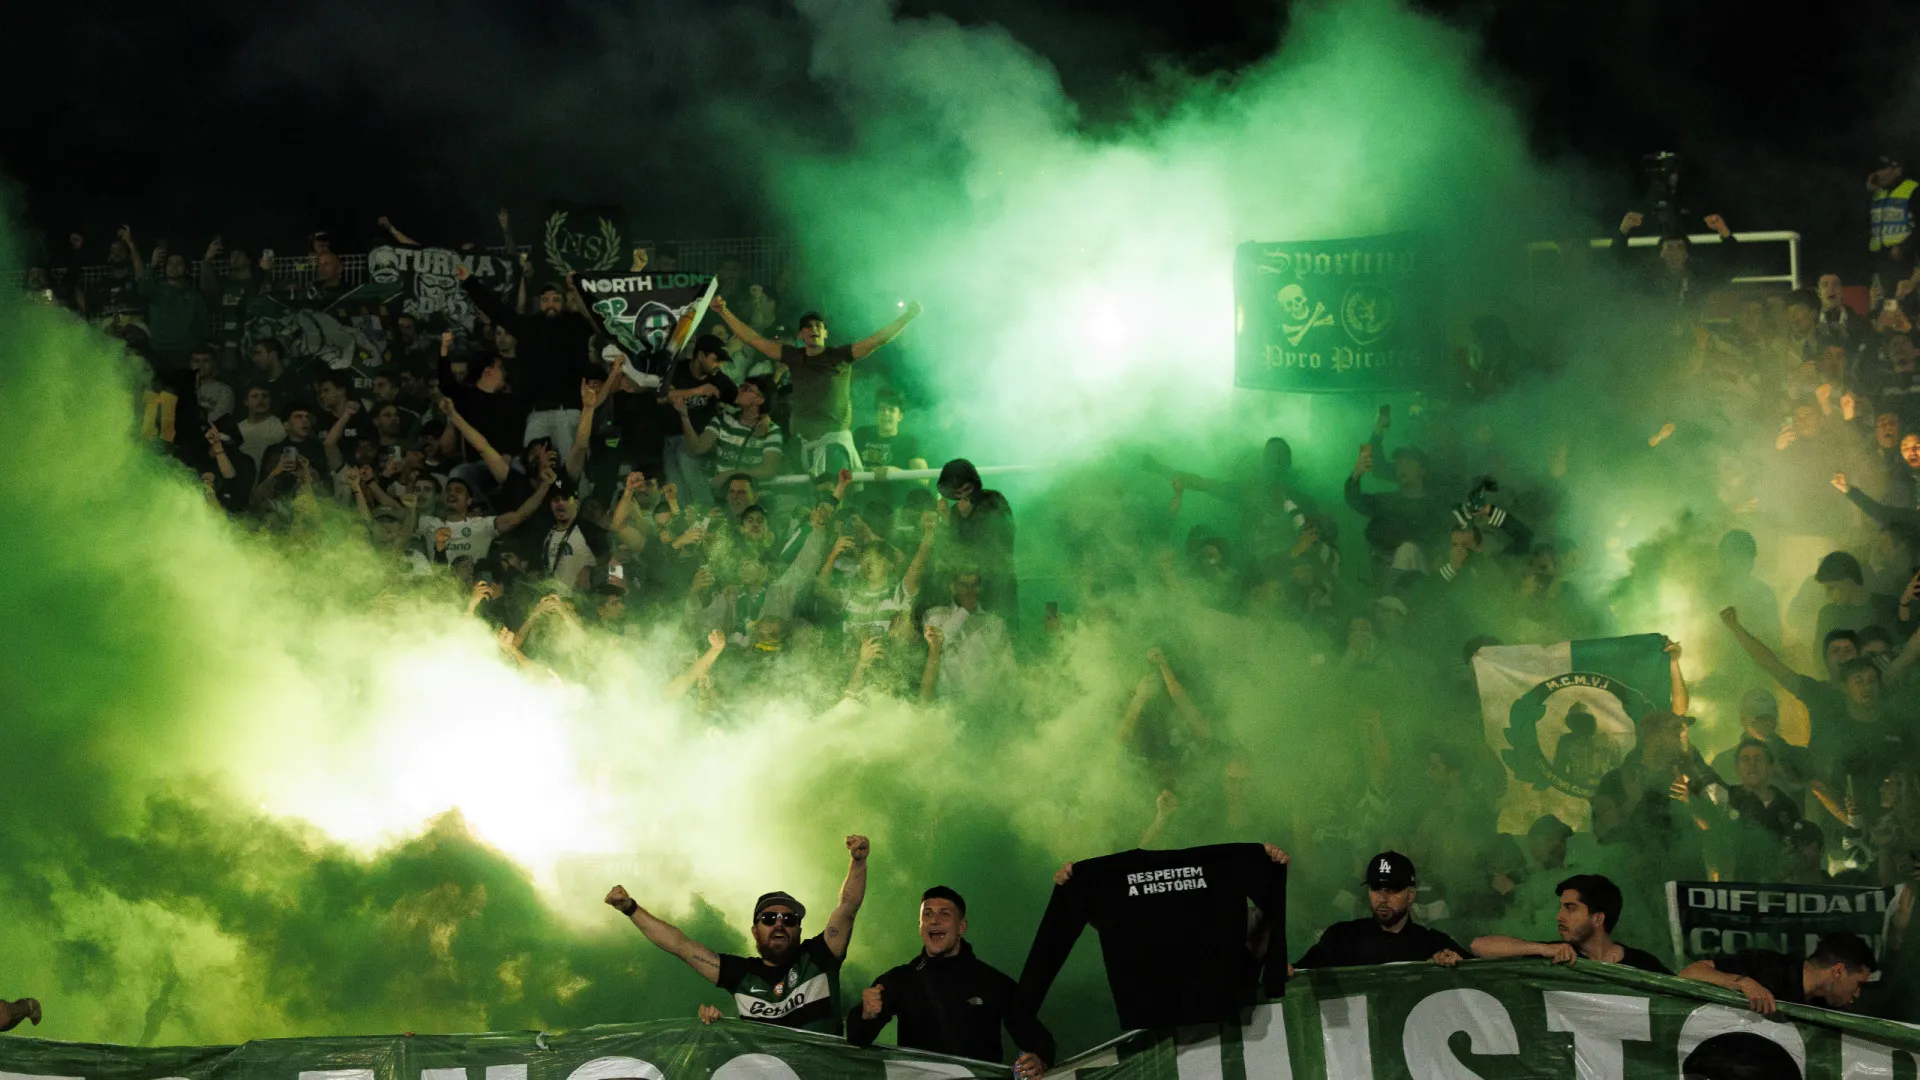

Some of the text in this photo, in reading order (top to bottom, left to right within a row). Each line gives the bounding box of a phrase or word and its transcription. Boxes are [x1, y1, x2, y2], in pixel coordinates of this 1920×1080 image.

[395, 248, 496, 277] TURMA
[581, 275, 652, 294] NORTH
[1262, 344, 1322, 371] Pyro
[1127, 866, 1204, 885] RESPEITEM
[1379, 858, 1392, 874] LA
[1128, 885, 1140, 897] A
